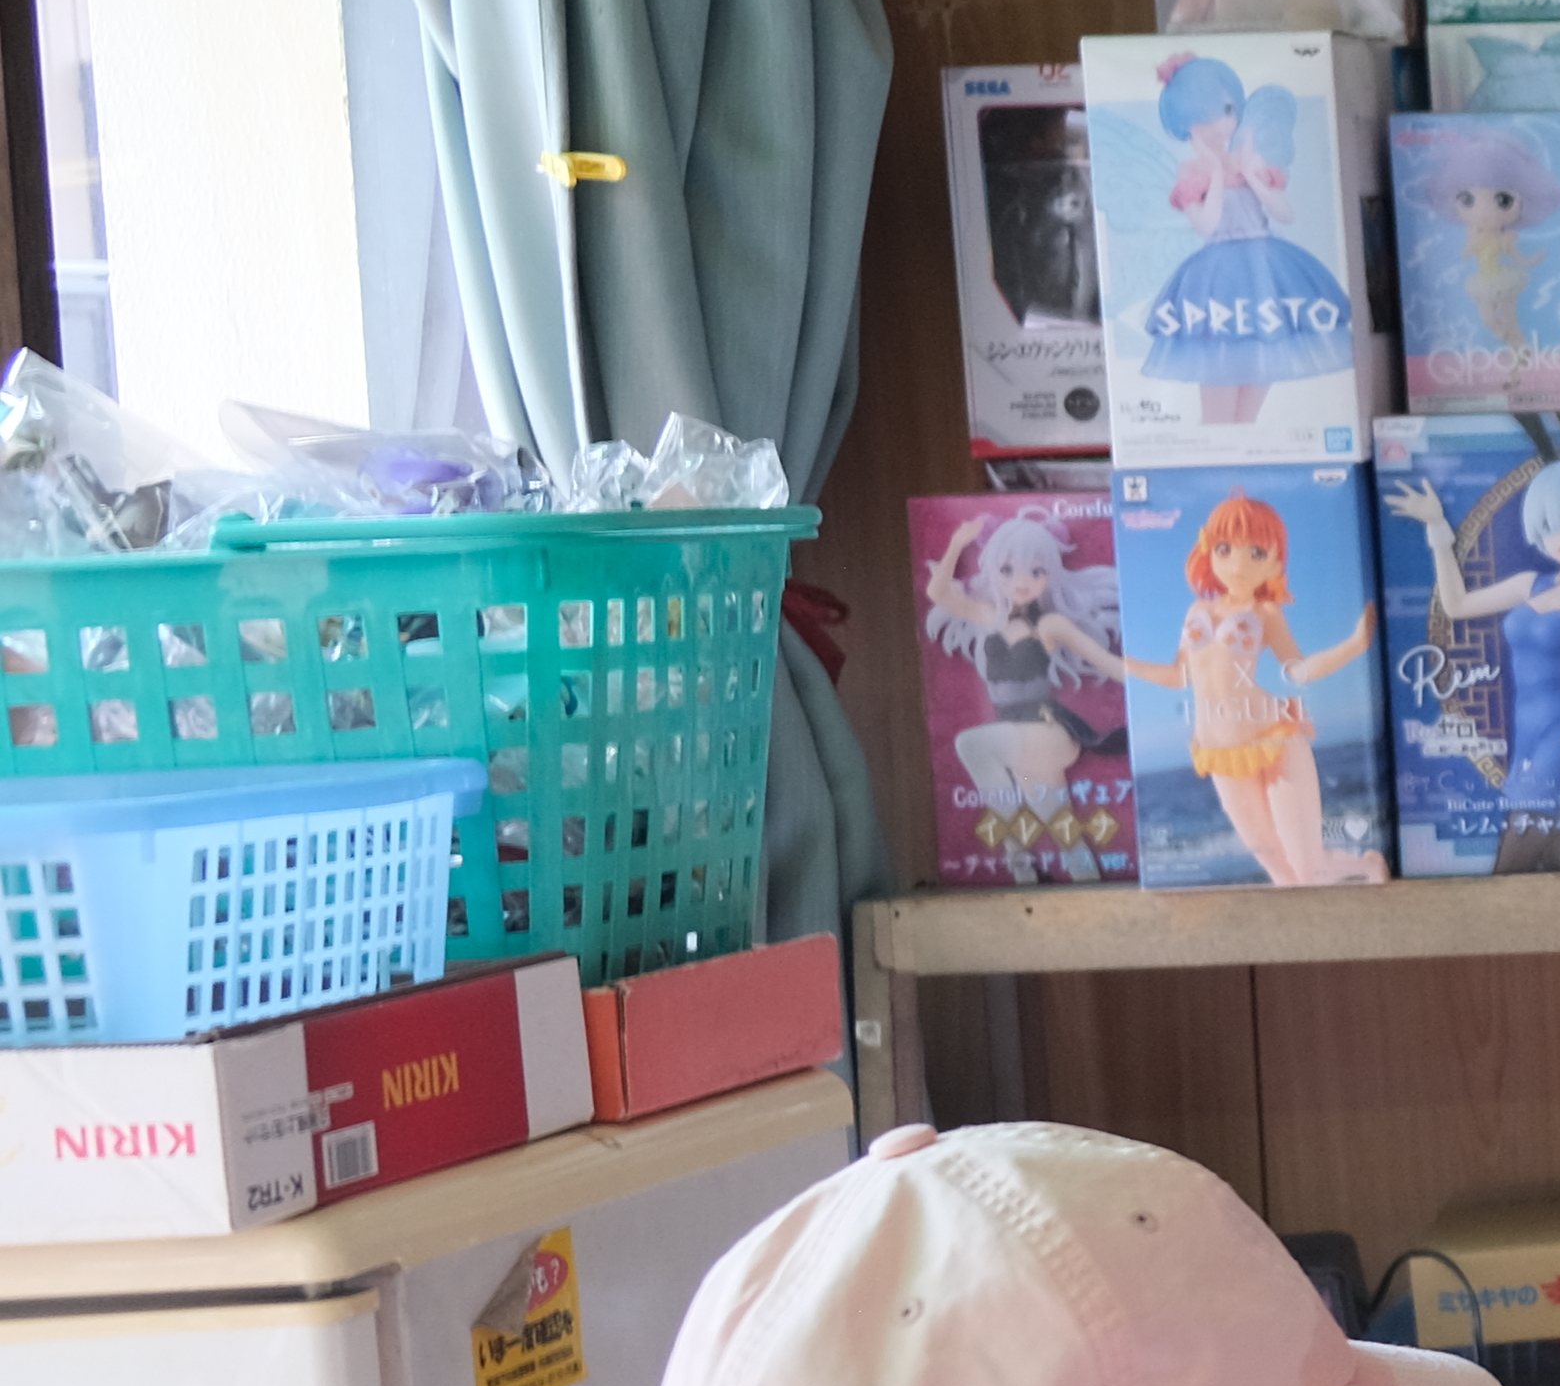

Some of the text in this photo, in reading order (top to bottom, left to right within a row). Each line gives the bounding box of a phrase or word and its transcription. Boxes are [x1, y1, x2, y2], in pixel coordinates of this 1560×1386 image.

[1154, 296, 1340, 337] SPRESTO
[1399, 645, 1501, 707] Rem
[381, 1051, 460, 1109] KIRIN
[54, 1122, 197, 1158] KIRIN
